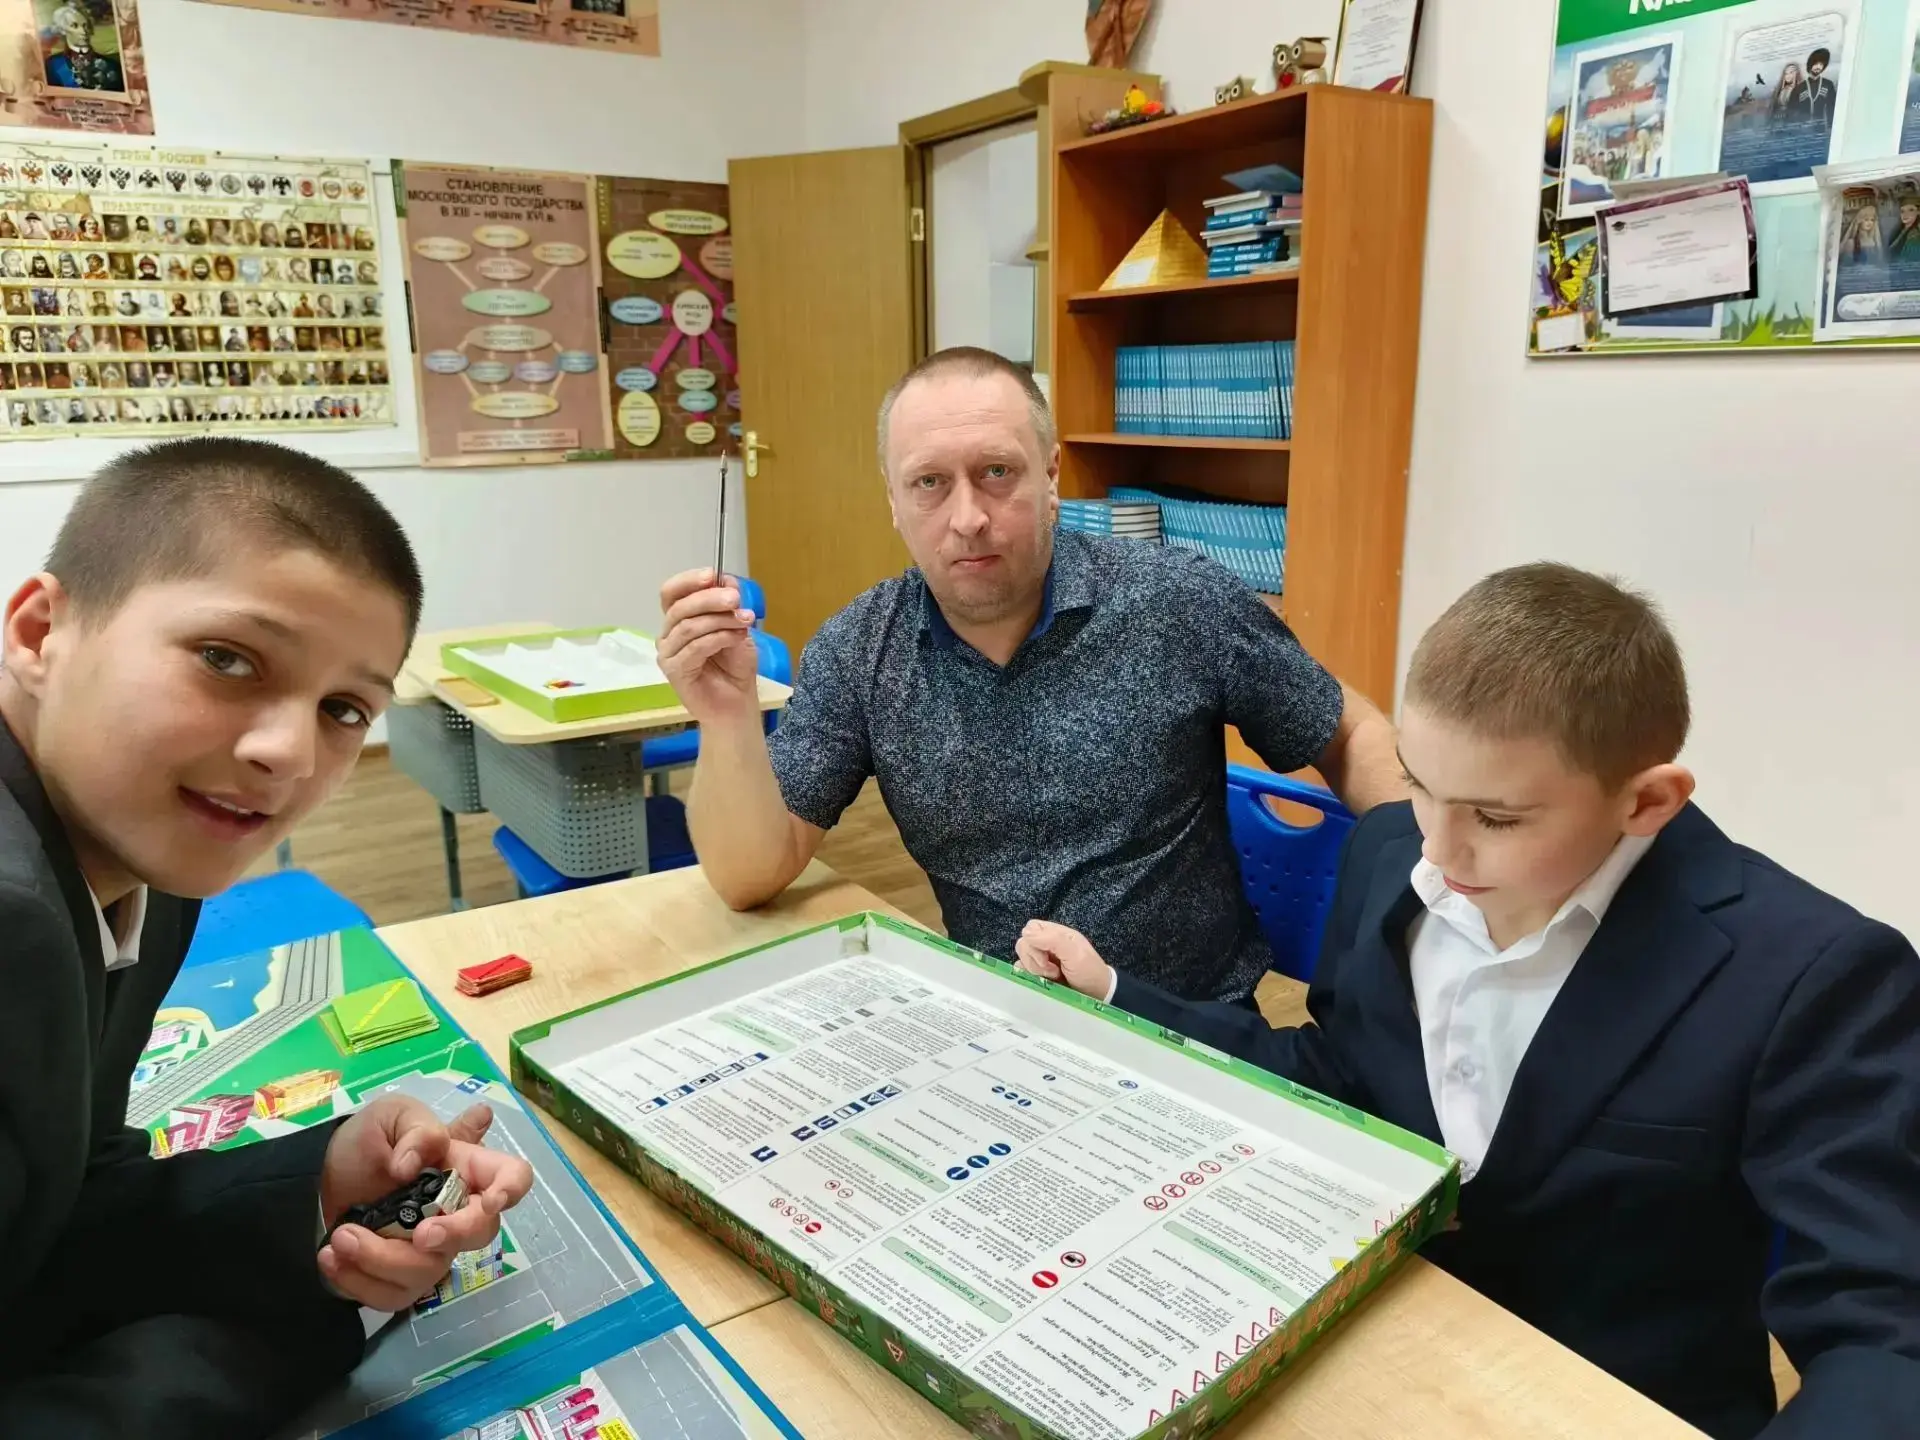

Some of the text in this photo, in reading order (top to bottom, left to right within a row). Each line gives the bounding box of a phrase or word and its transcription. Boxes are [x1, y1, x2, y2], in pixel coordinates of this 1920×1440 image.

[158, 152, 206, 165] РОССИИ
[408, 190, 585, 211] МОСКОВСКОГО ГОСУДАРСТВА
[446, 178, 545, 196] СТАНОВЛЕНИЕ
[440, 206, 449, 217] В
[484, 210, 523, 221] начале
[902, 1250, 925, 1265] знаки
[1191, 1236, 1244, 1266] приоритета
[921, 1263, 979, 1301] Запрещающие
[1240, 1265, 1270, 1283] Знаки
[1058, 1327, 1132, 1378] Железнодорожный
[1100, 1323, 1153, 1358] Пересечение
[1033, 1343, 1109, 1398] Железнодорожный
[1083, 1335, 1157, 1387] езд без шлагбаума.
[1058, 1351, 1134, 1407] езд со шлагбаумом.
